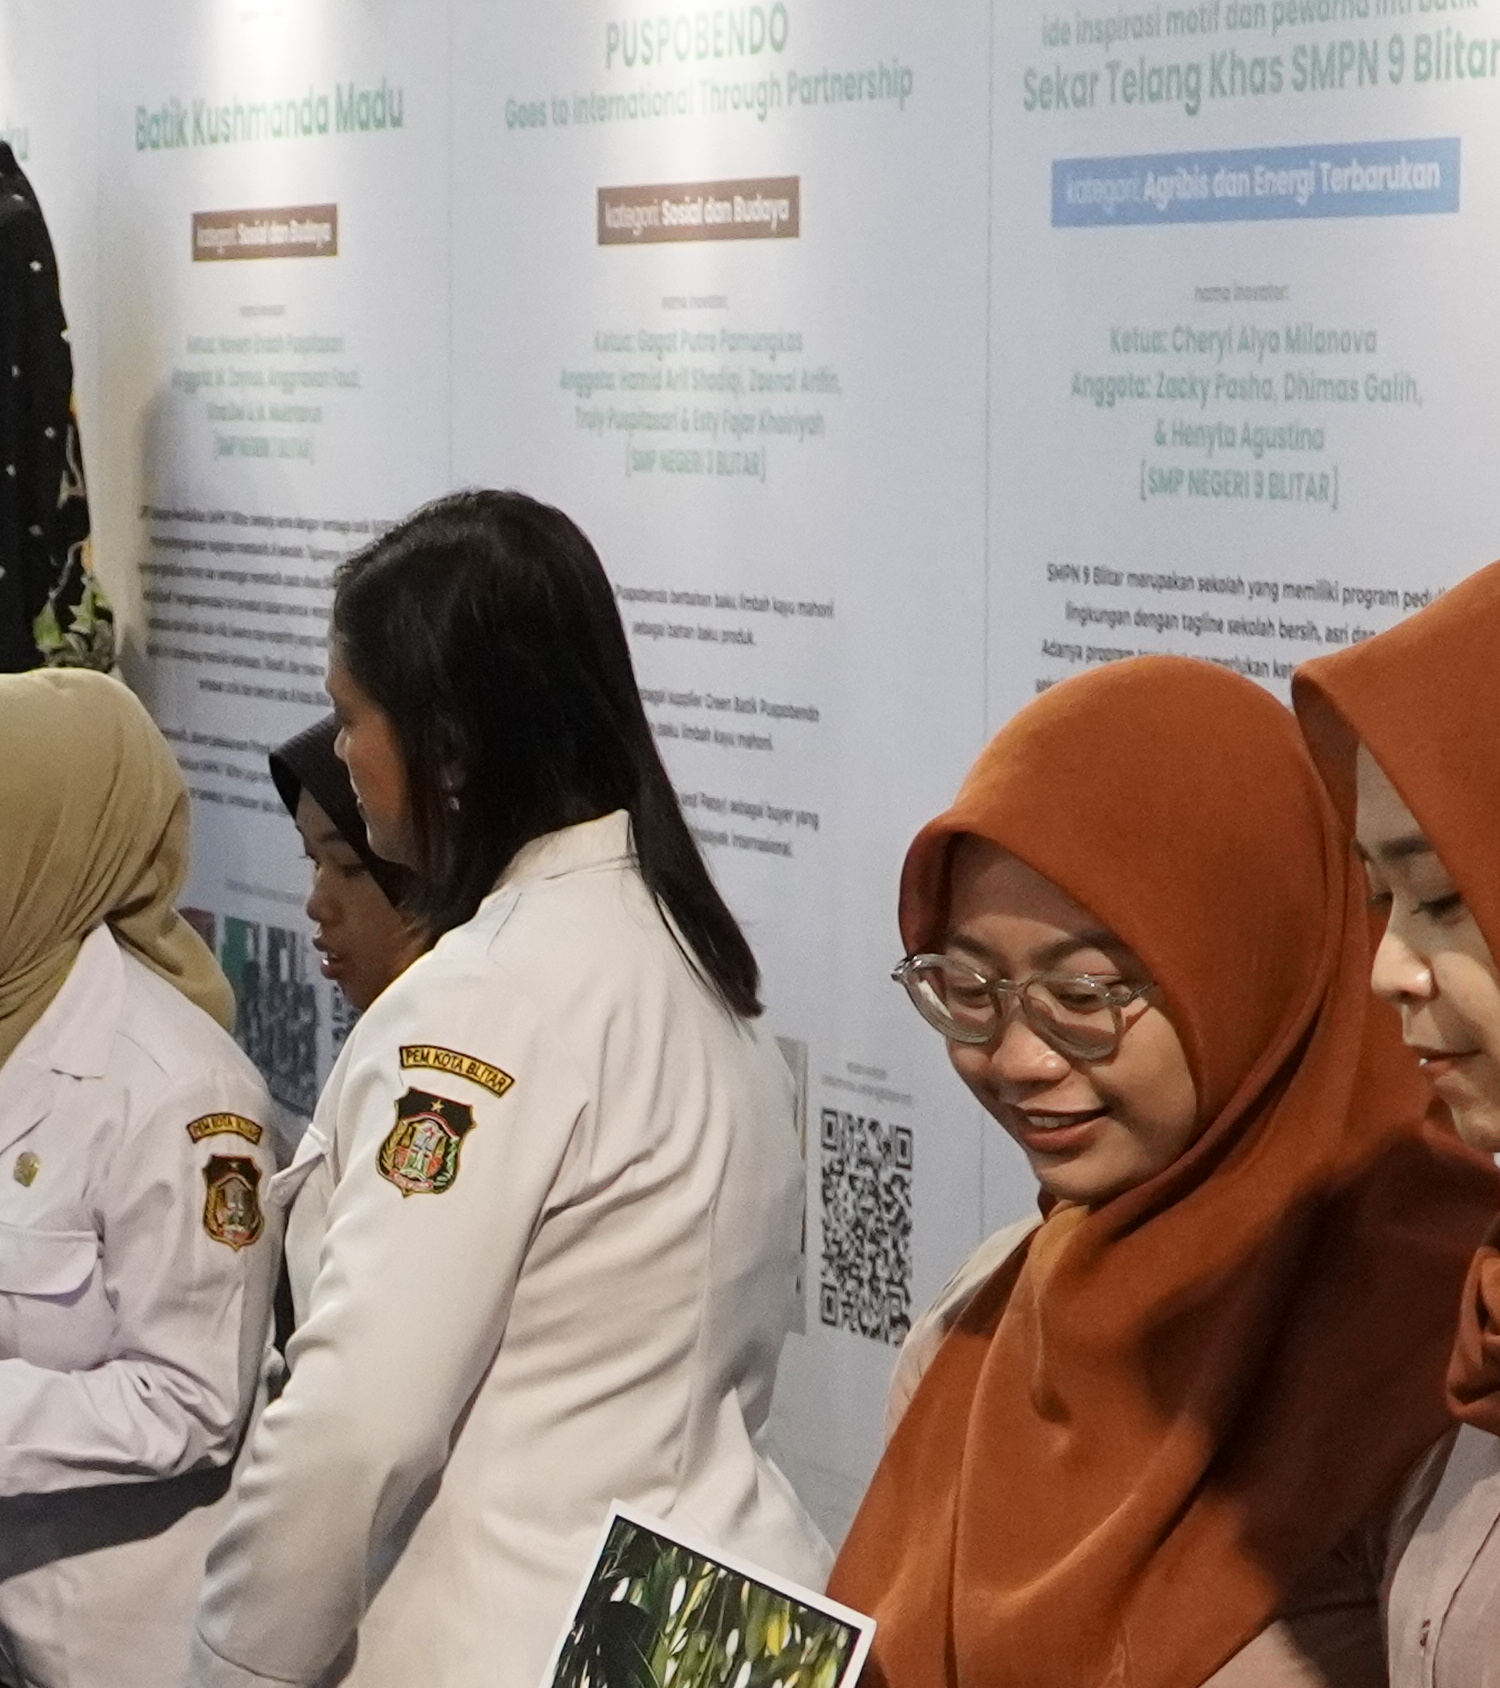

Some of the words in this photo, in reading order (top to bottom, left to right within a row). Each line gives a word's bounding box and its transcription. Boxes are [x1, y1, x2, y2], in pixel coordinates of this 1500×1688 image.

[603, 2, 790, 70] PUSPOBENDO
[786, 57, 914, 112] Partnership
[1022, 64, 1100, 112] Sekar
[1105, 56, 1202, 117] Telang
[1208, 47, 1284, 99] Khas
[1291, 37, 1379, 94] SMPN
[1387, 32, 1406, 85] 9
[335, 75, 404, 133] Madu
[1143, 166, 1210, 211] Agribis
[1213, 165, 1250, 199] dan
[1253, 159, 1316, 206] Energi
[1319, 156, 1441, 195] Terbarukan
[405, 1048, 430, 1065] PEM
[432, 1051, 464, 1073] KOTA
[465, 1061, 507, 1089] BLITAR
